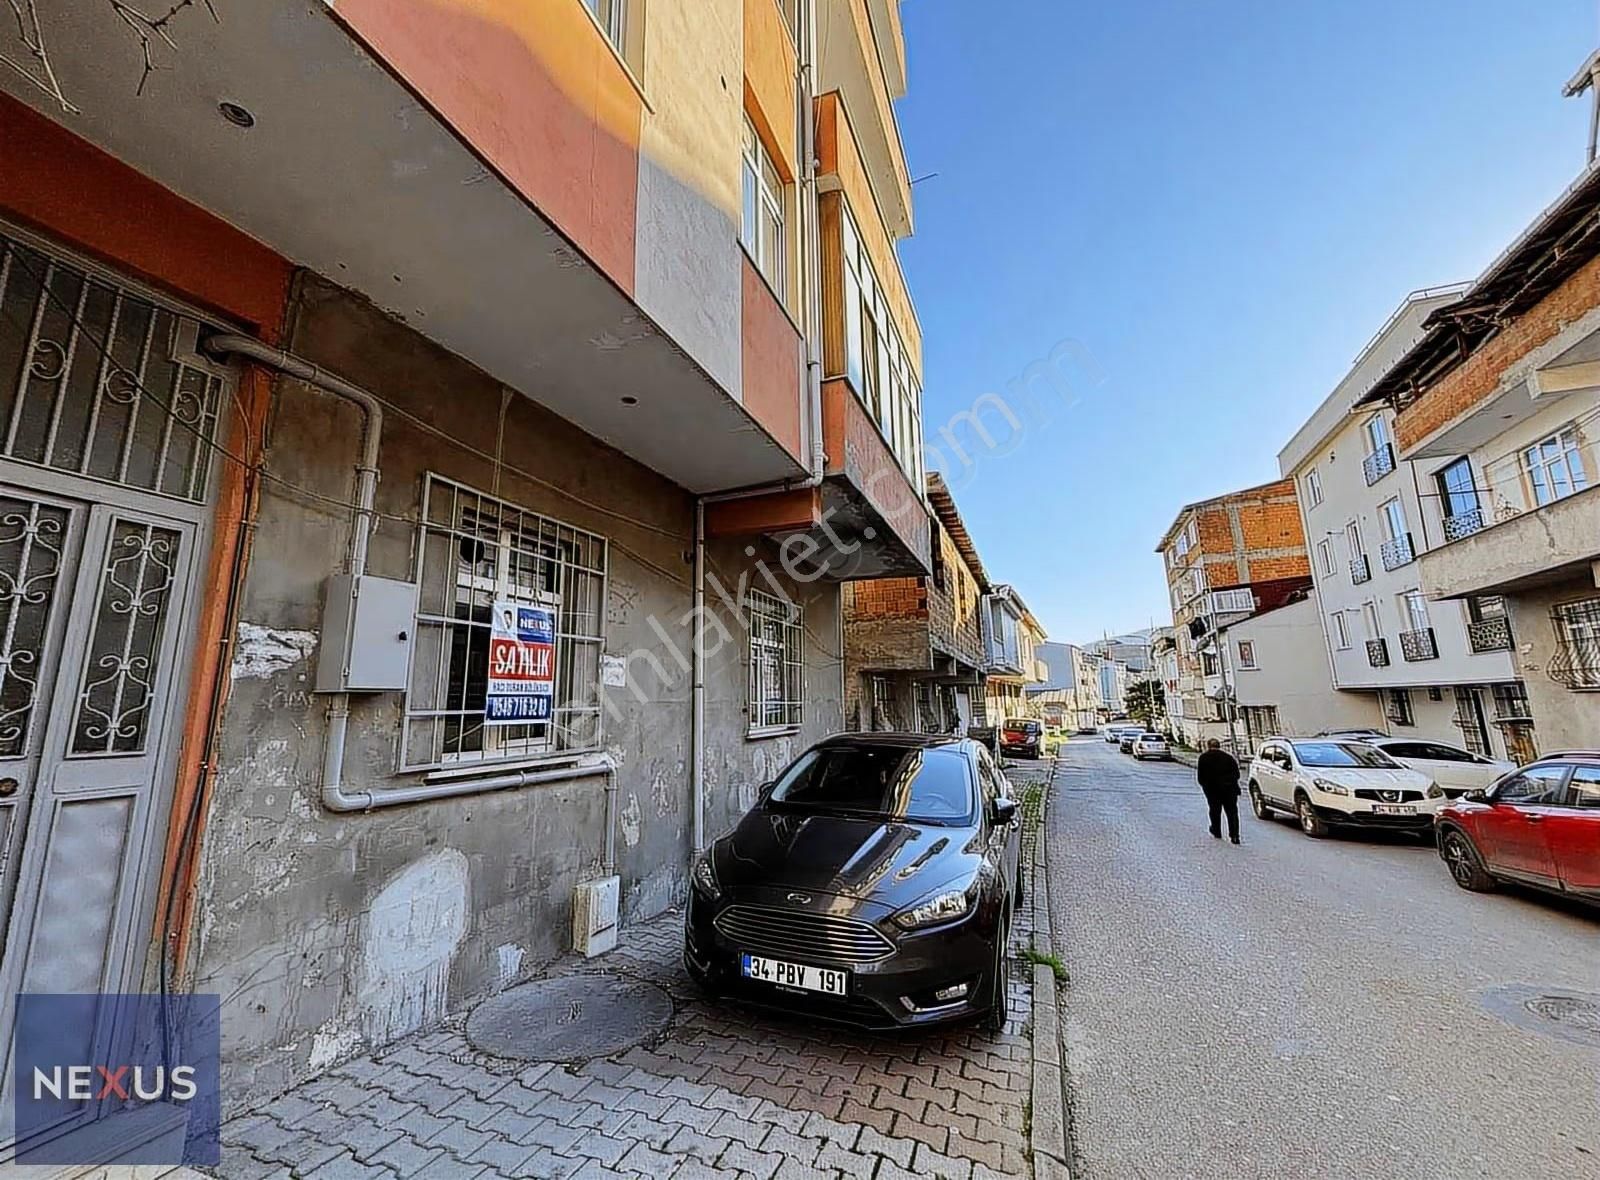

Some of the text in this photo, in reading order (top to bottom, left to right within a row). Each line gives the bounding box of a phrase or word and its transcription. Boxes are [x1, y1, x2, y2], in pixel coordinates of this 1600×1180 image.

[752, 958, 770, 979] 34
[777, 962, 806, 986] PBV
[819, 970, 844, 994] 191
